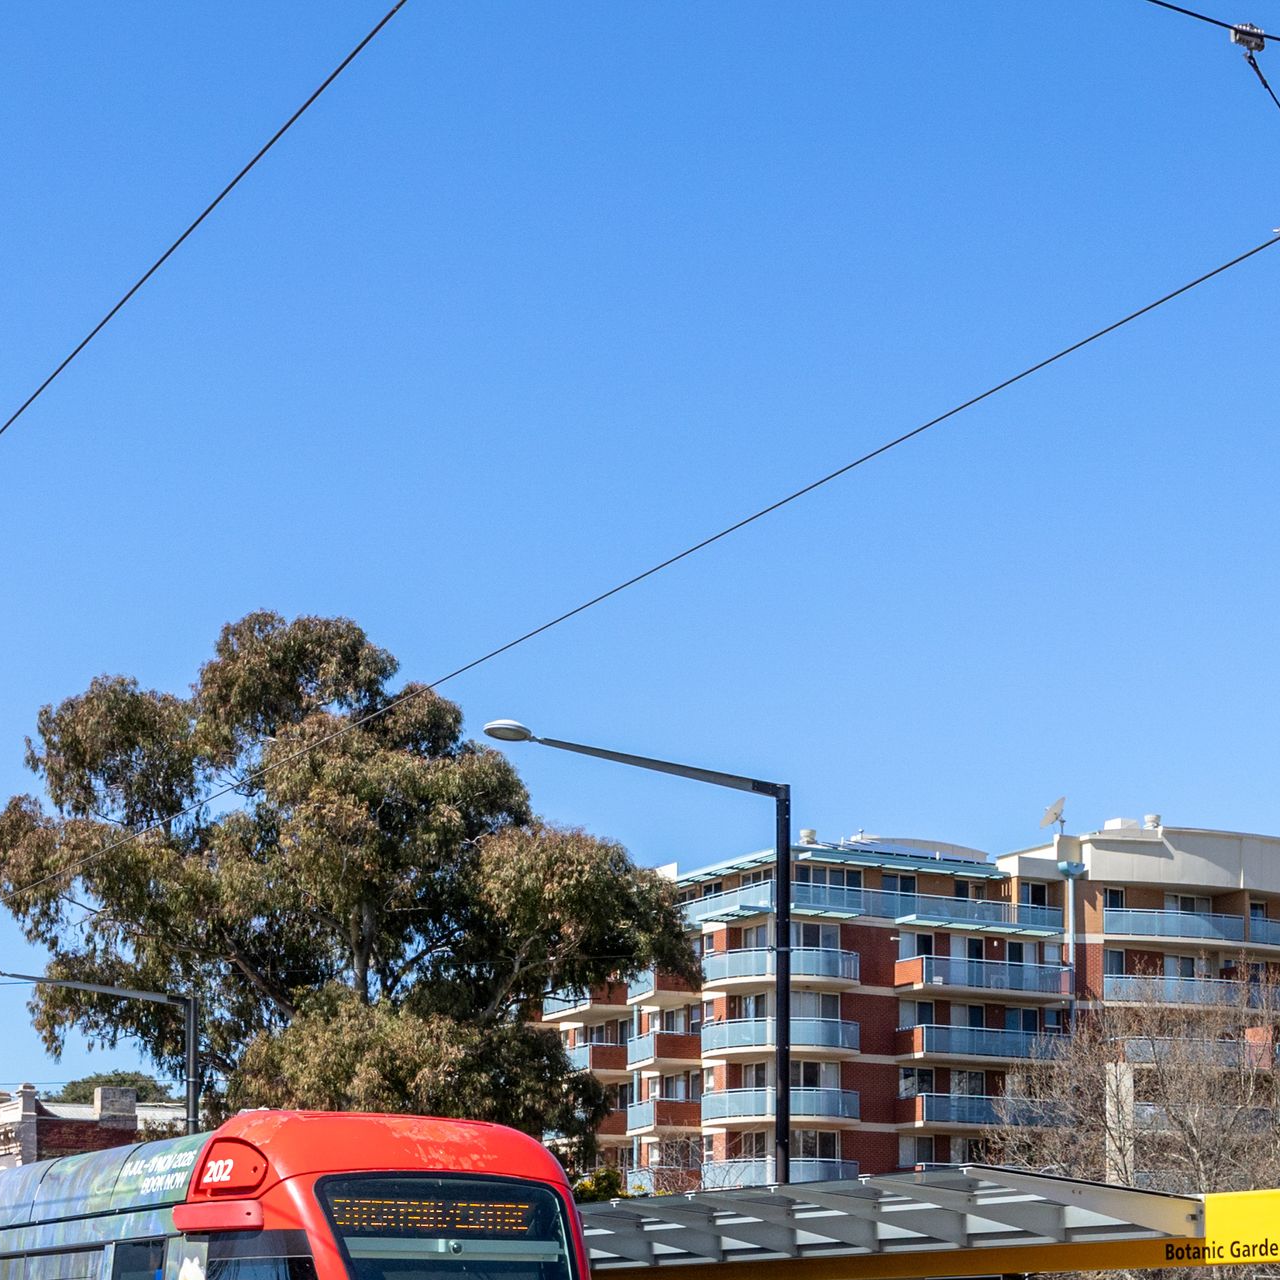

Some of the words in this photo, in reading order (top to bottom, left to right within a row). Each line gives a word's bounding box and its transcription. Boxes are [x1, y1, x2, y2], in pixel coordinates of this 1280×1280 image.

[203, 1158, 234, 1183] 202
[141, 1175, 166, 1194] BOOK
[164, 1171, 188, 1191] NOW
[1165, 1241, 1224, 1260] Botanic
